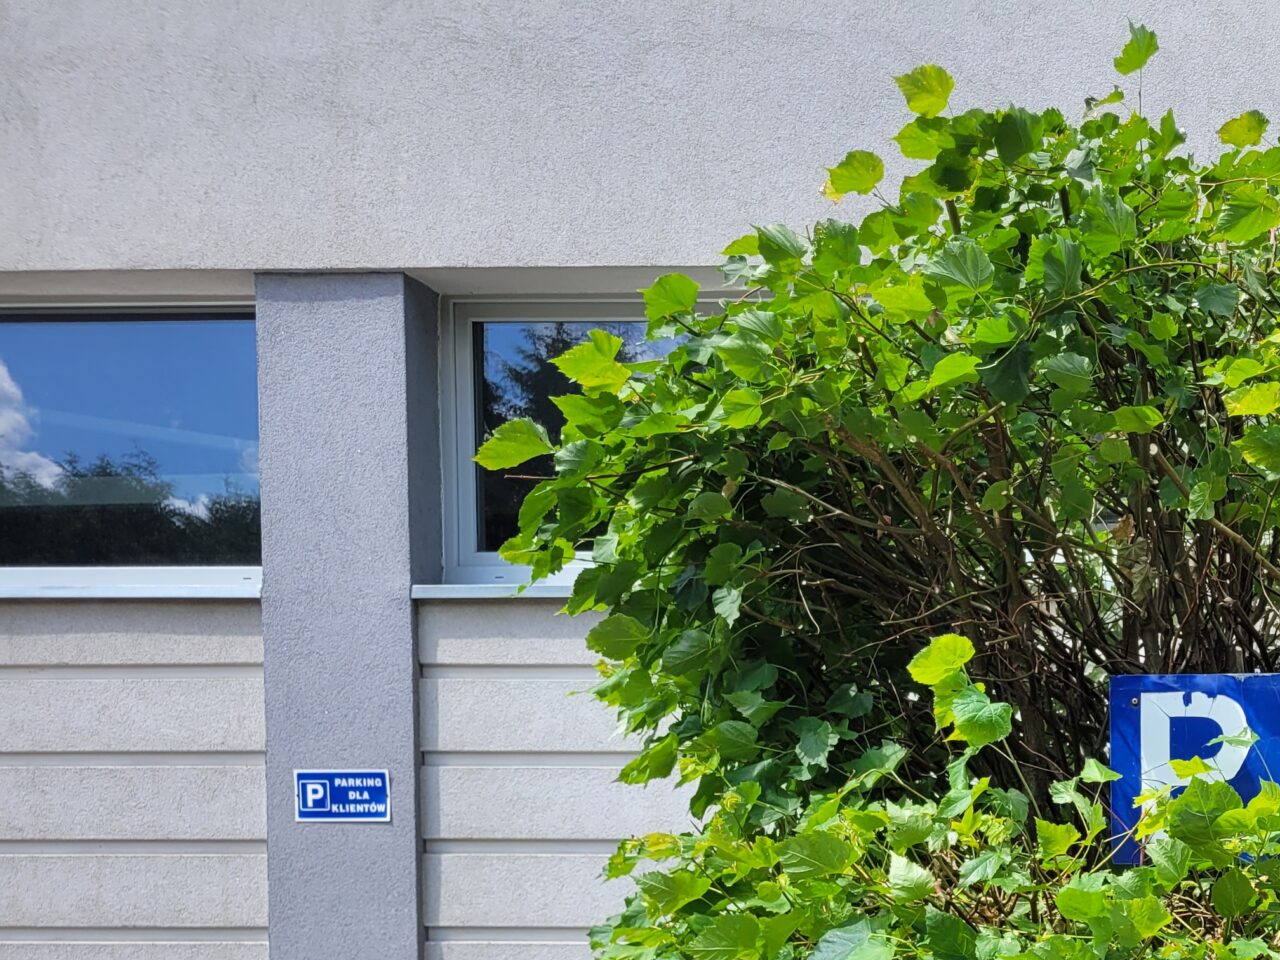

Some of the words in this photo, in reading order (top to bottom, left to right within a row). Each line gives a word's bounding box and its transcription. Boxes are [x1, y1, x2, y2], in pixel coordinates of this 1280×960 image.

[1140, 691, 1253, 846] P
[334, 778, 382, 787] PARKING
[306, 783, 324, 808] P
[348, 791, 370, 800] DLA
[331, 802, 386, 813] KLIENTÓW
